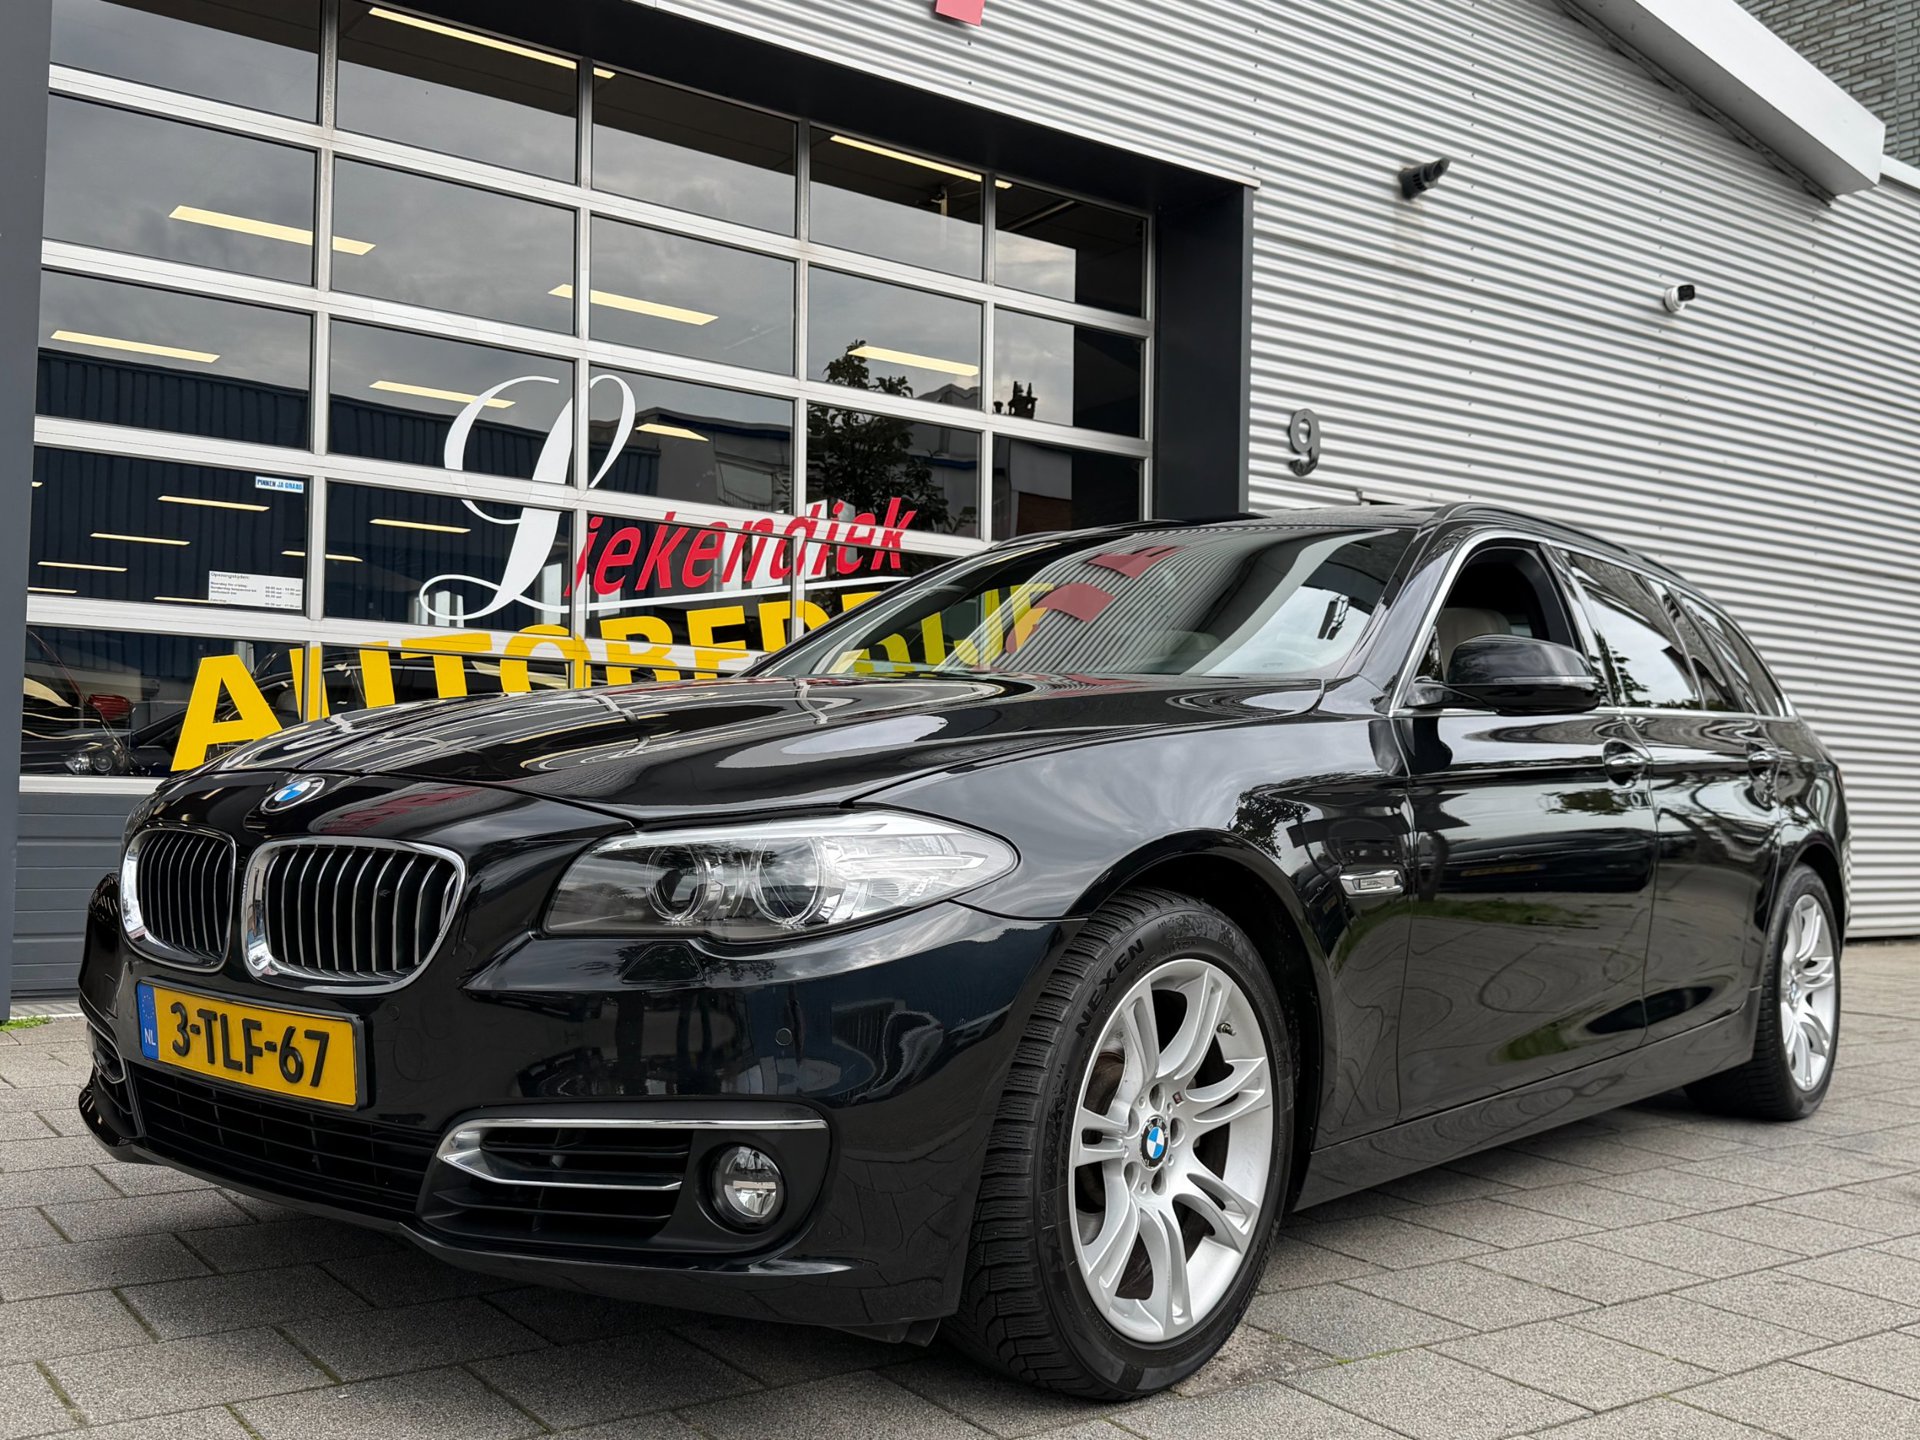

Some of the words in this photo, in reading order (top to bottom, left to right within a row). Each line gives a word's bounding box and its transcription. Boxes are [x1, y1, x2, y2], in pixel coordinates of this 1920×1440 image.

[1288, 408, 1320, 477] 9
[1075, 938, 1145, 1038] NEXEN
[144, 1027, 157, 1046] NL
[170, 1001, 330, 1088] 3-TLF-67
